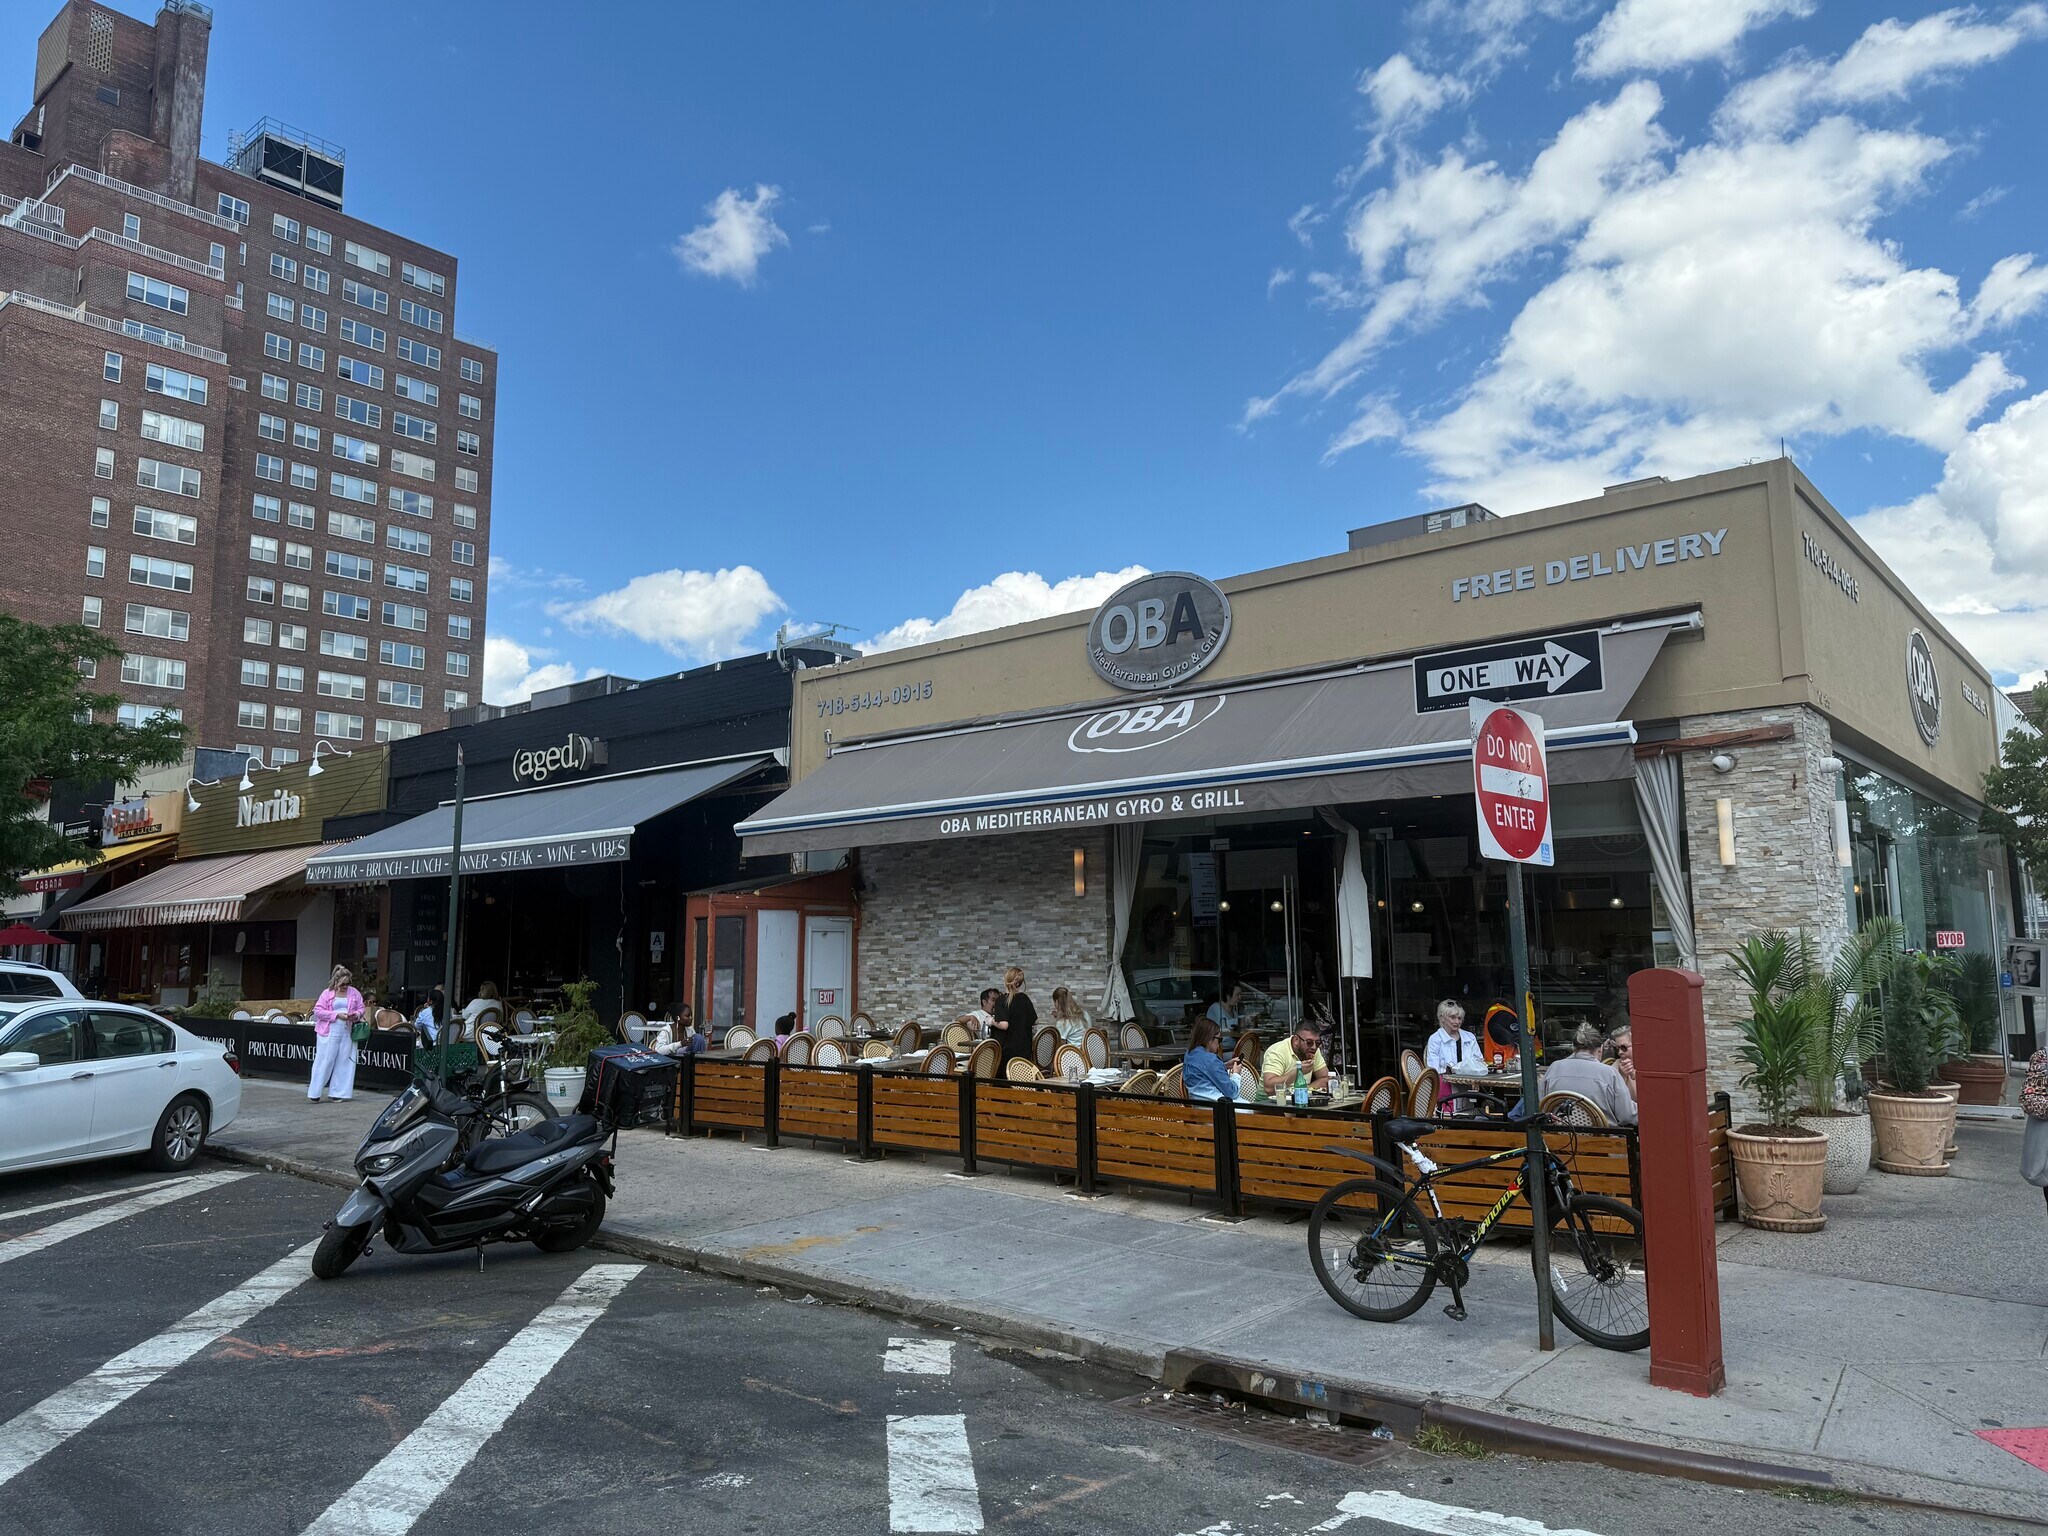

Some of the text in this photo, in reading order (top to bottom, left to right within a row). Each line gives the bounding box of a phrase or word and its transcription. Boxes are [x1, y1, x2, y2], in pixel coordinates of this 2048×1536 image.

[1452, 528, 1729, 602] FREE DELIVERY
[1802, 530, 1859, 603] 718-544-0915
[1101, 591, 1205, 655] OBA
[1093, 646, 1159, 683] Mediterranean
[1162, 662, 1189, 678] Gyro
[1191, 652, 1201, 668] &
[1440, 653, 1571, 692] ONE WAY
[1911, 646, 1938, 711] OBA
[817, 681, 933, 718] 718-544-0915
[1086, 700, 1195, 738] OBA
[1487, 734, 1533, 766] DO NOT
[235, 788, 301, 828] Narita
[940, 789, 1245, 834] OBA MEDITERRANEAN GYRO & GRILL
[1495, 802, 1536, 832] ENTER
[306, 838, 626, 881] HAPPY HOUR BRUNCH LUNCH INNER STEAK WINE VIBES
[35, 878, 63, 891] CABANA
[653, 934, 662, 946] A
[1937, 933, 1963, 945] BYOB
[819, 991, 834, 1004] EXIT
[248, 1041, 267, 1057] PRIX
[268, 1043, 286, 1058] FIXE
[357, 1049, 409, 1071] ESTAURANT
